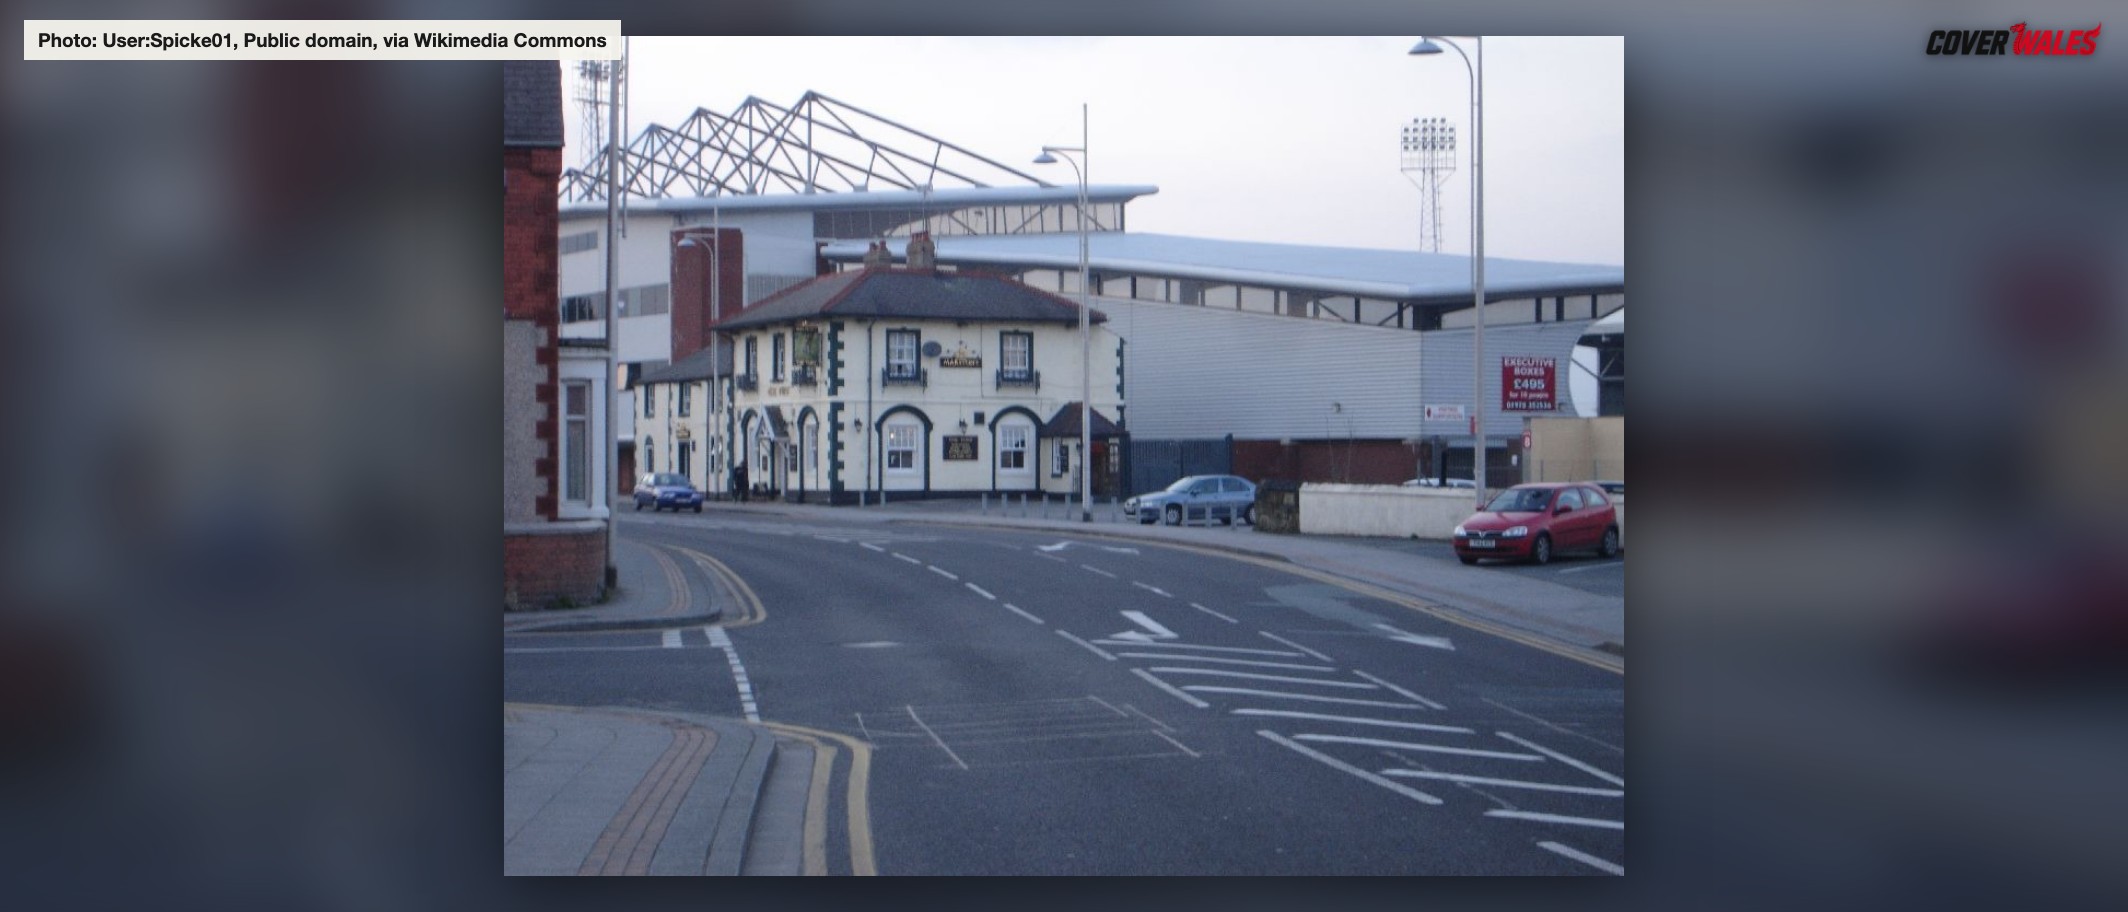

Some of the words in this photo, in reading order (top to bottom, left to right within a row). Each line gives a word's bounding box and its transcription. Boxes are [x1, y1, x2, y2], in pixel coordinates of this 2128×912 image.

[1504, 358, 1554, 367] EXECUTIVE
[1514, 367, 1545, 376] BOXES
[1513, 378, 1545, 390] £495
